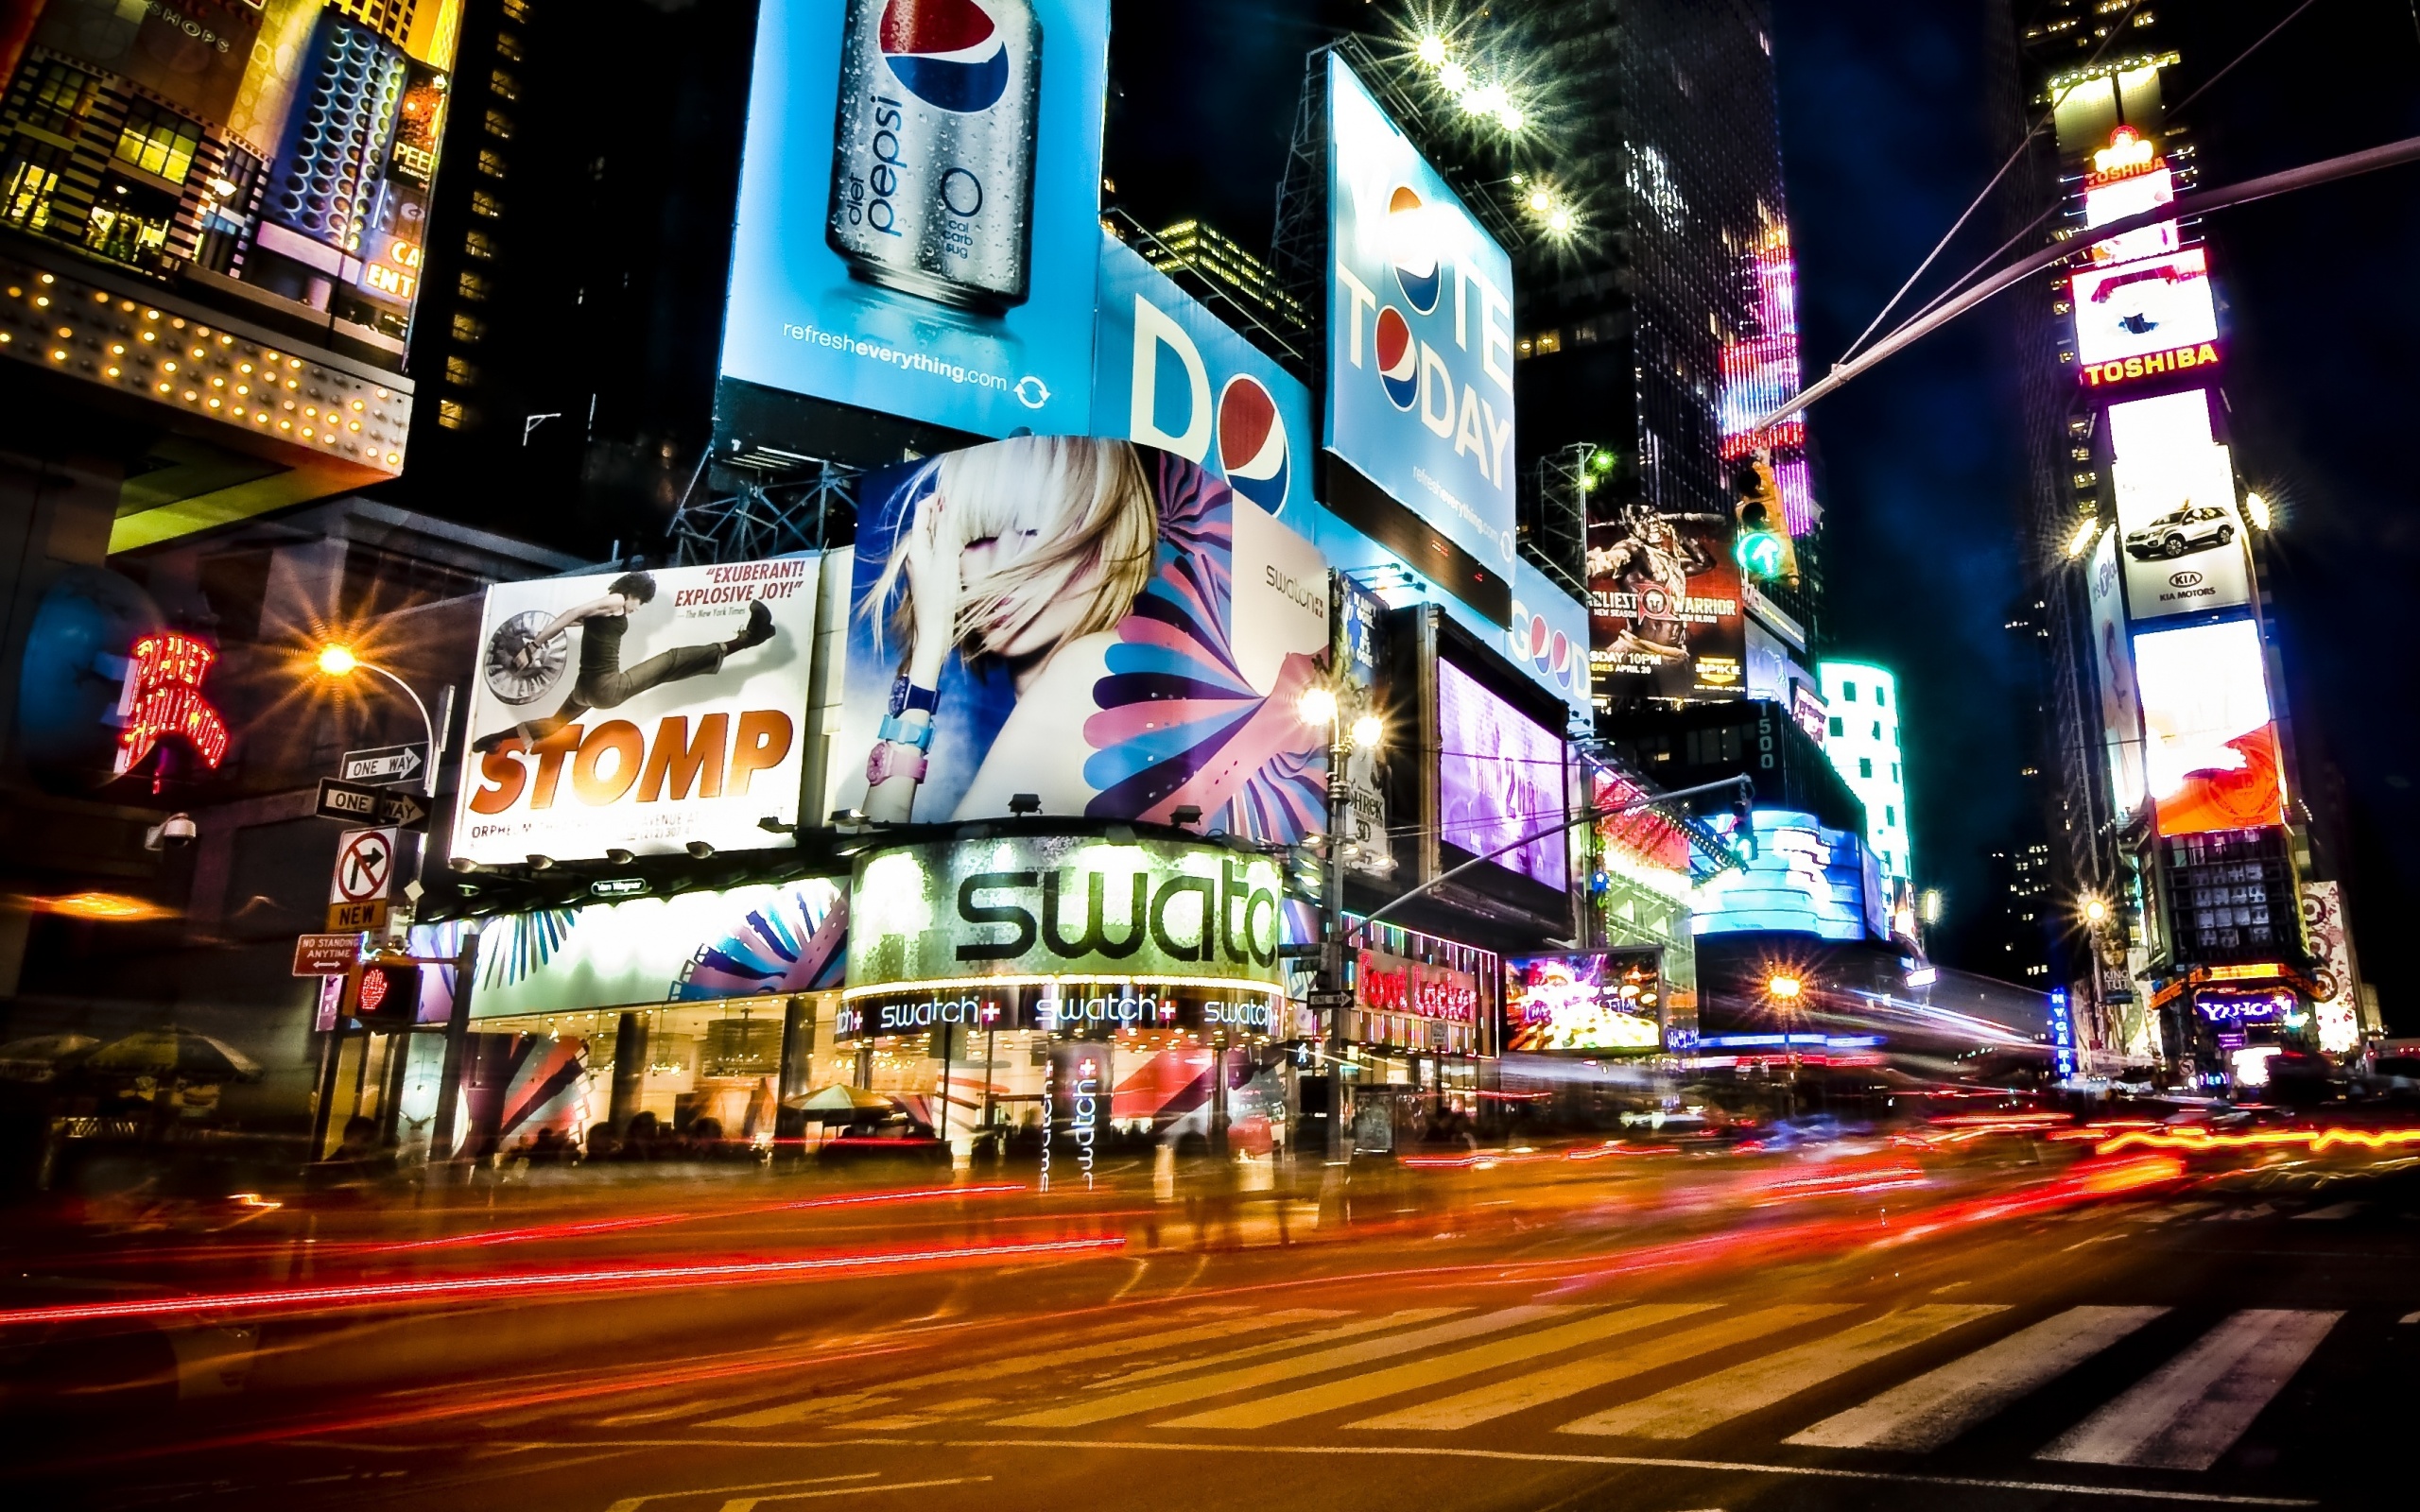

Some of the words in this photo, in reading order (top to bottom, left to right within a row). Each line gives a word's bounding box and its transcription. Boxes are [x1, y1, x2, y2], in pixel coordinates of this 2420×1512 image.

[147, 1, 230, 53] SHOPS
[867, 95, 908, 238] pepsi
[2084, 157, 2167, 185] TOSHIBA
[848, 172, 865, 227] diet
[947, 219, 970, 234] cal
[943, 229, 974, 248] carb
[945, 244, 969, 259] sug
[783, 320, 1008, 391] refresheverything.com
[2084, 344, 2220, 387] TOSHIBA
[2174, 573, 2199, 585] KIA
[675, 585, 755, 607] EXPLOSIVE
[2159, 592, 2176, 602] KIA
[2177, 587, 2216, 599] MOTORS
[728, 607, 746, 616] Times
[1671, 595, 1737, 616] WARRIOR
[1615, 663, 1640, 674] APRIL
[1628, 652, 1662, 665] 10PM
[353, 761, 379, 776] ONE
[389, 756, 415, 772] WAY
[469, 710, 793, 816] STOMP
[335, 793, 370, 810] ONE
[384, 799, 416, 819] WAY
[1356, 818, 1372, 842] 3D
[338, 905, 375, 926] NEW
[956, 858, 1280, 971] swatc
[302, 938, 313, 948] NO
[318, 938, 360, 948] STANDING
[307, 949, 351, 958] ANYTIME
[2103, 971, 2129, 980] KING
[2104, 980, 2128, 990] TUT
[1358, 953, 1409, 1012] Foot
[1412, 964, 1478, 1023] Locker
[881, 995, 979, 1028] swatch
[1034, 992, 1157, 1022] swatch
[1203, 998, 1273, 1026] swatch
